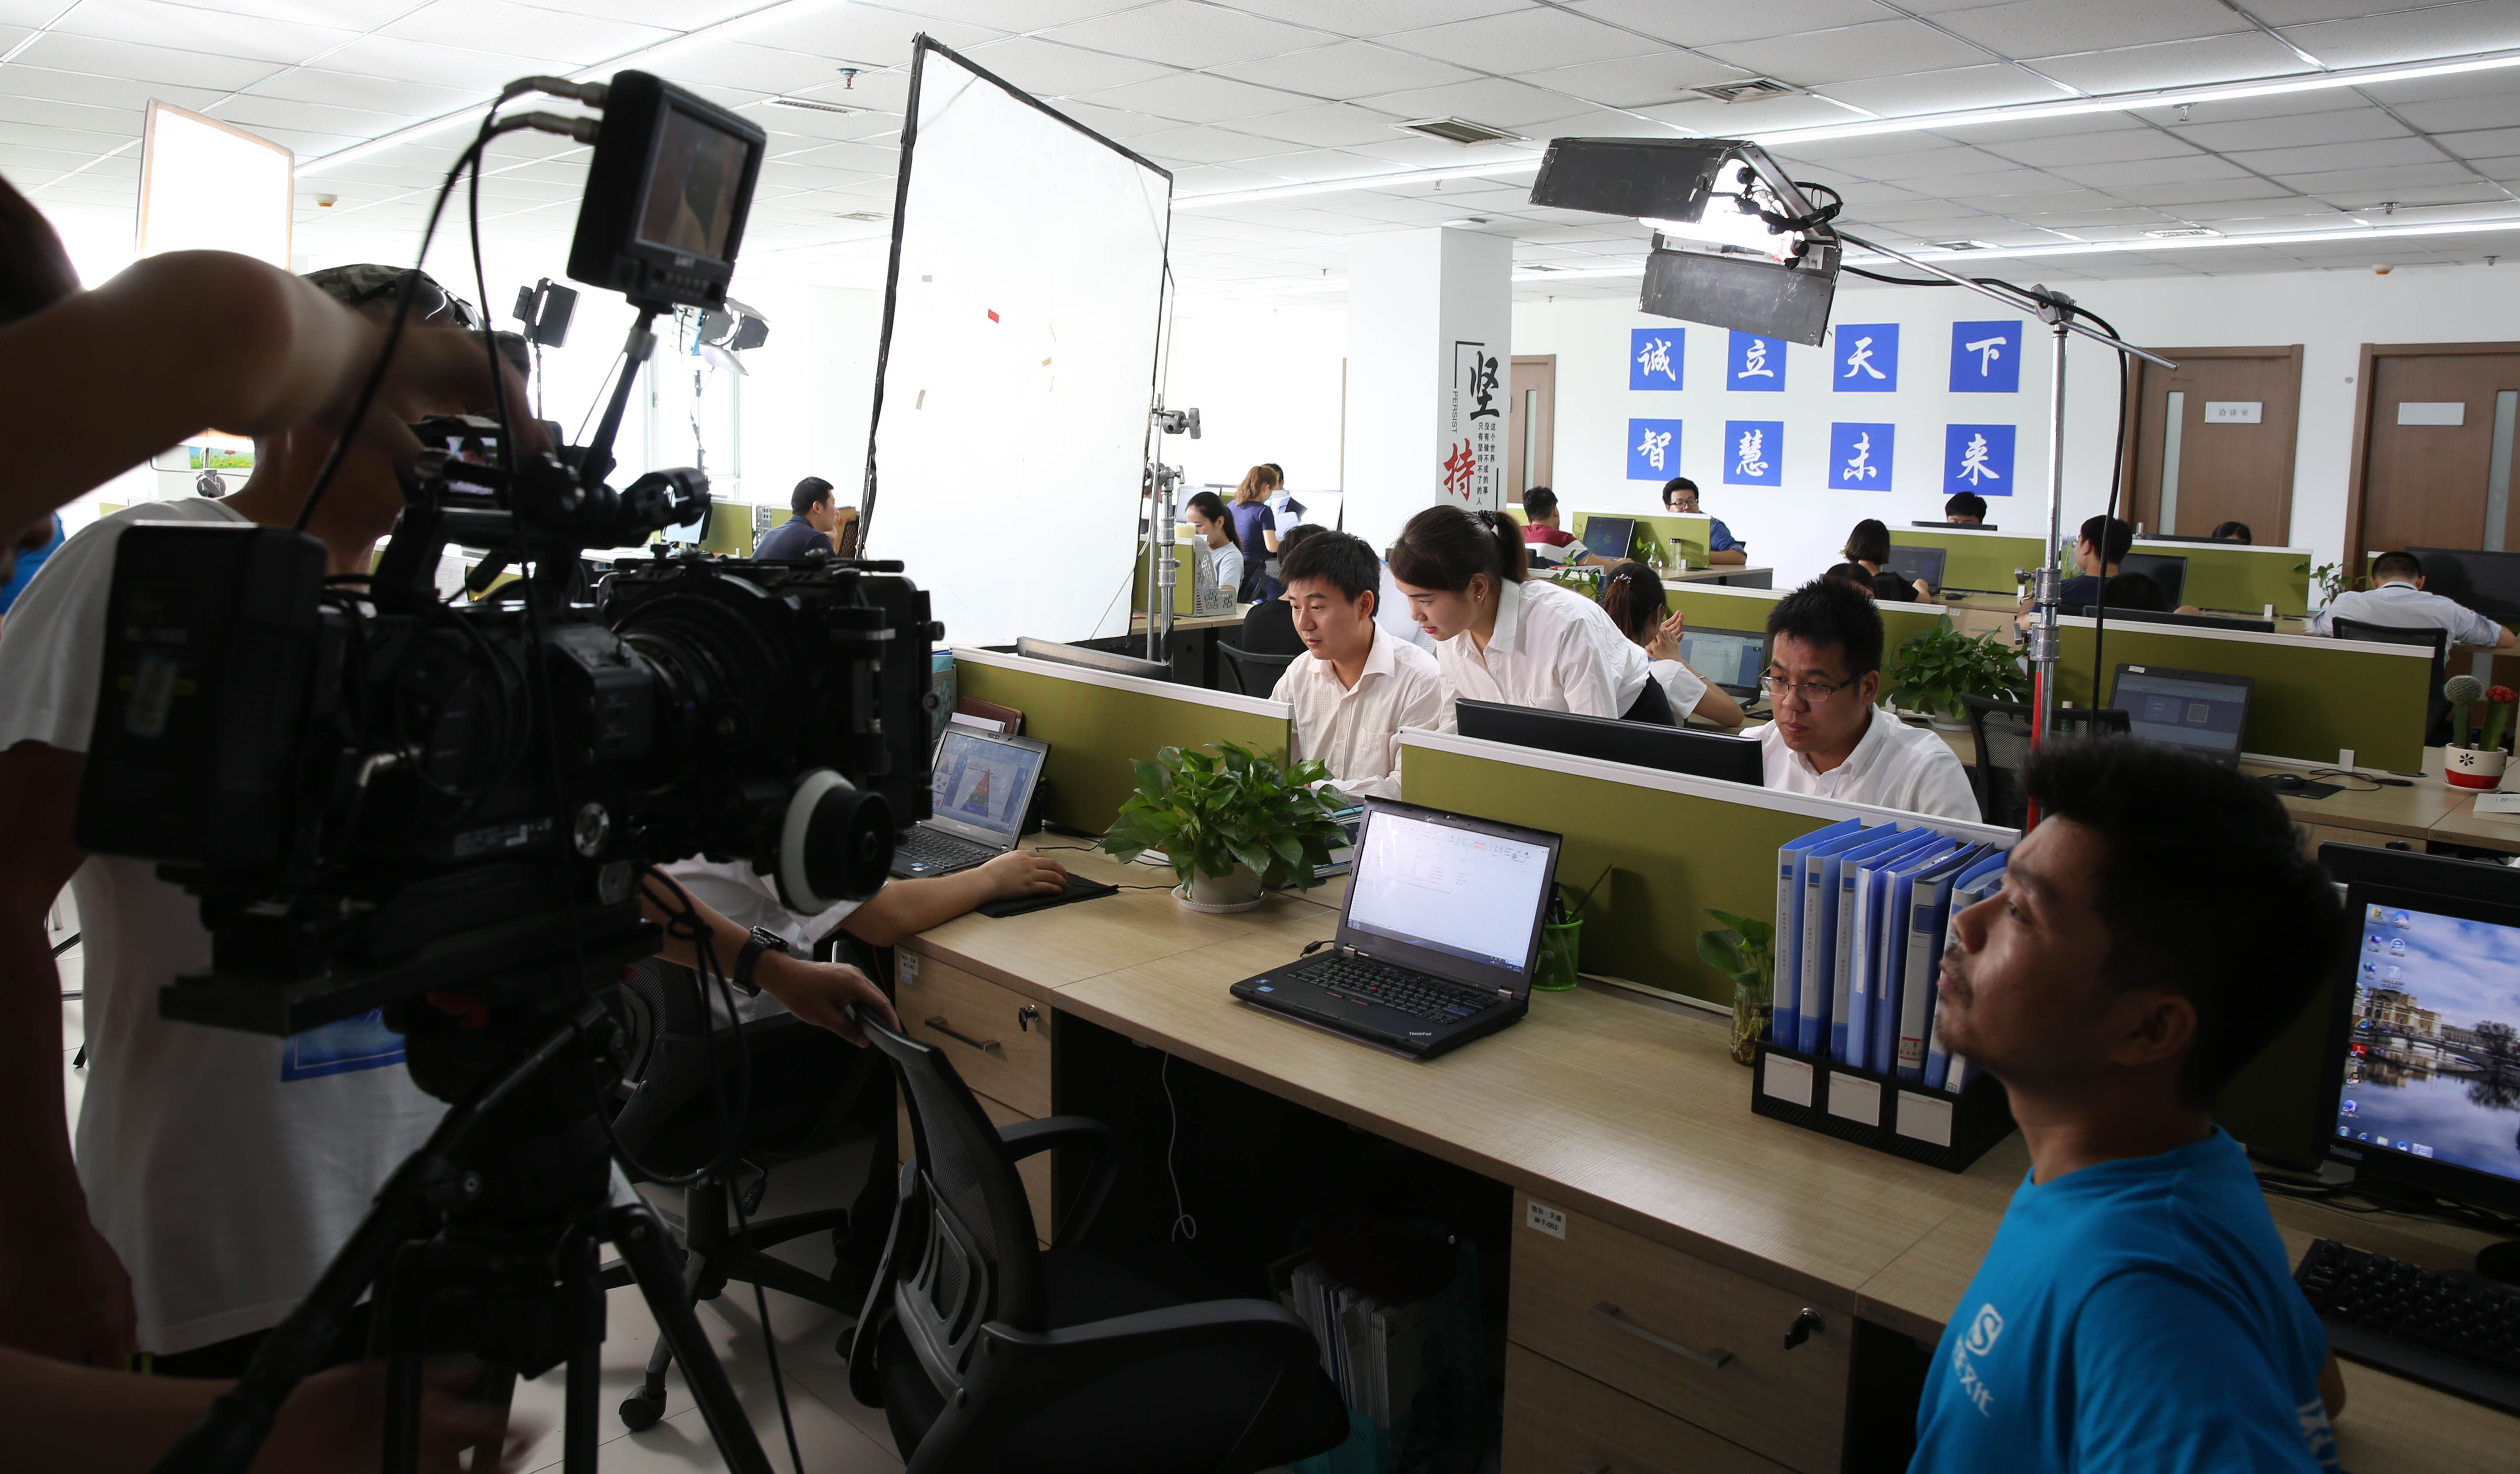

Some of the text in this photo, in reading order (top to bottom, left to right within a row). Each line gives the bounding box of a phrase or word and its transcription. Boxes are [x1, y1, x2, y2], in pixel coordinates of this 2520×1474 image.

[1470, 351, 1500, 421] 坚
[1637, 337, 2007, 382] 诚 立 天 下
[1443, 438, 1477, 501] 持
[1637, 428, 2000, 486] 智 慧 未 来
